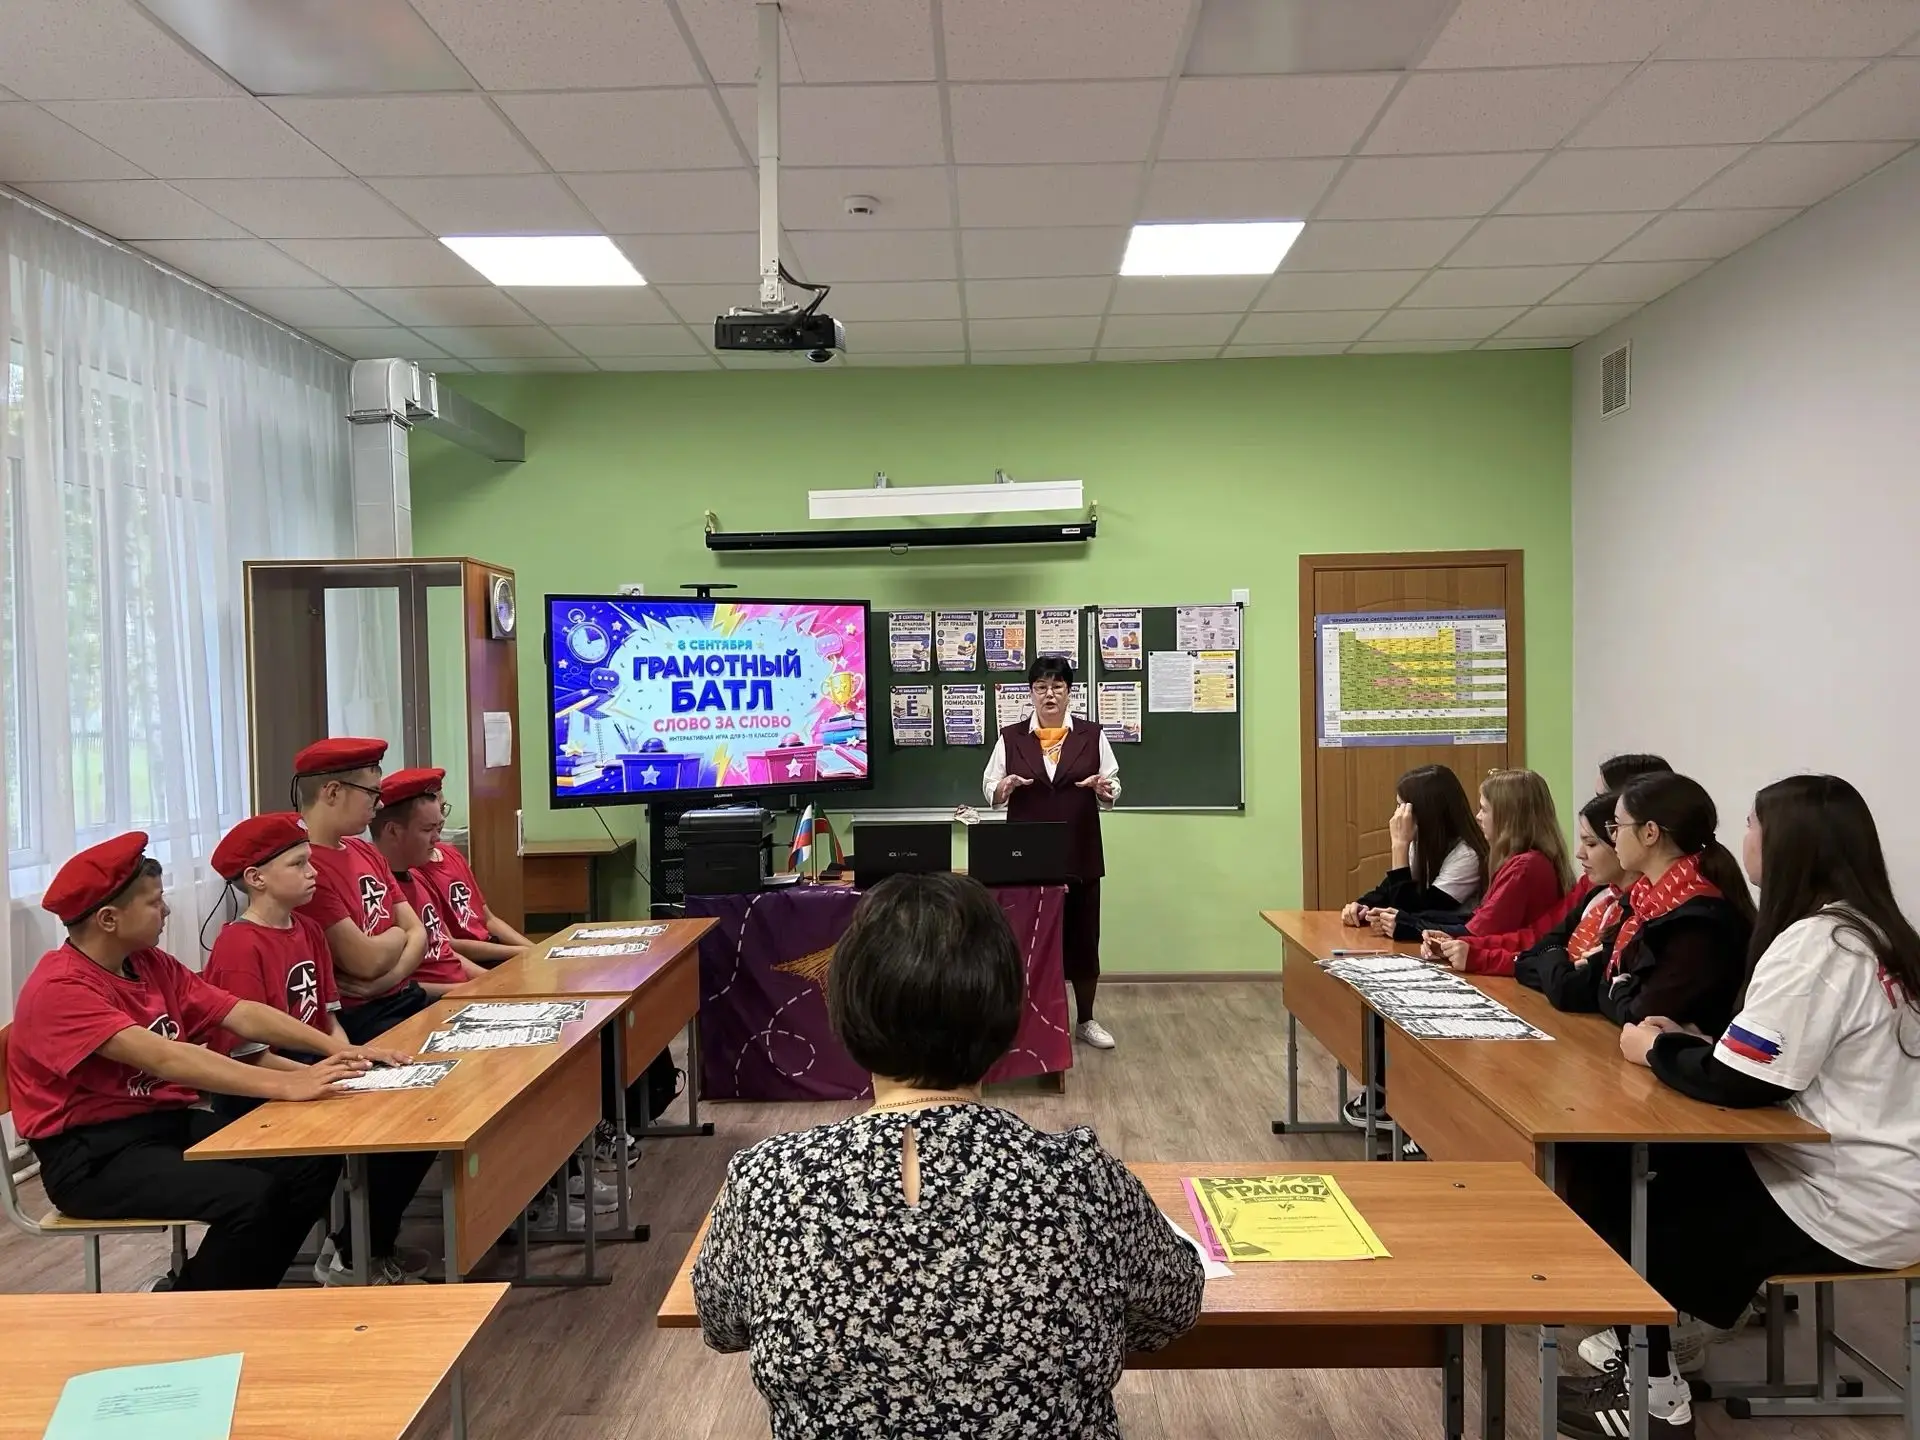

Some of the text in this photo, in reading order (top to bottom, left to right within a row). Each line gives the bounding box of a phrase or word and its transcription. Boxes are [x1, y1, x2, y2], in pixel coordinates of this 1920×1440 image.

[677, 640, 753, 650] 8 СЕНТЯБРЯ
[633, 648, 802, 681] ГРАМОТНЫЙ
[671, 680, 774, 713] БАТЛ
[906, 696, 918, 716] Ё
[654, 715, 792, 732] СЛОВО ЗА СЛОВО
